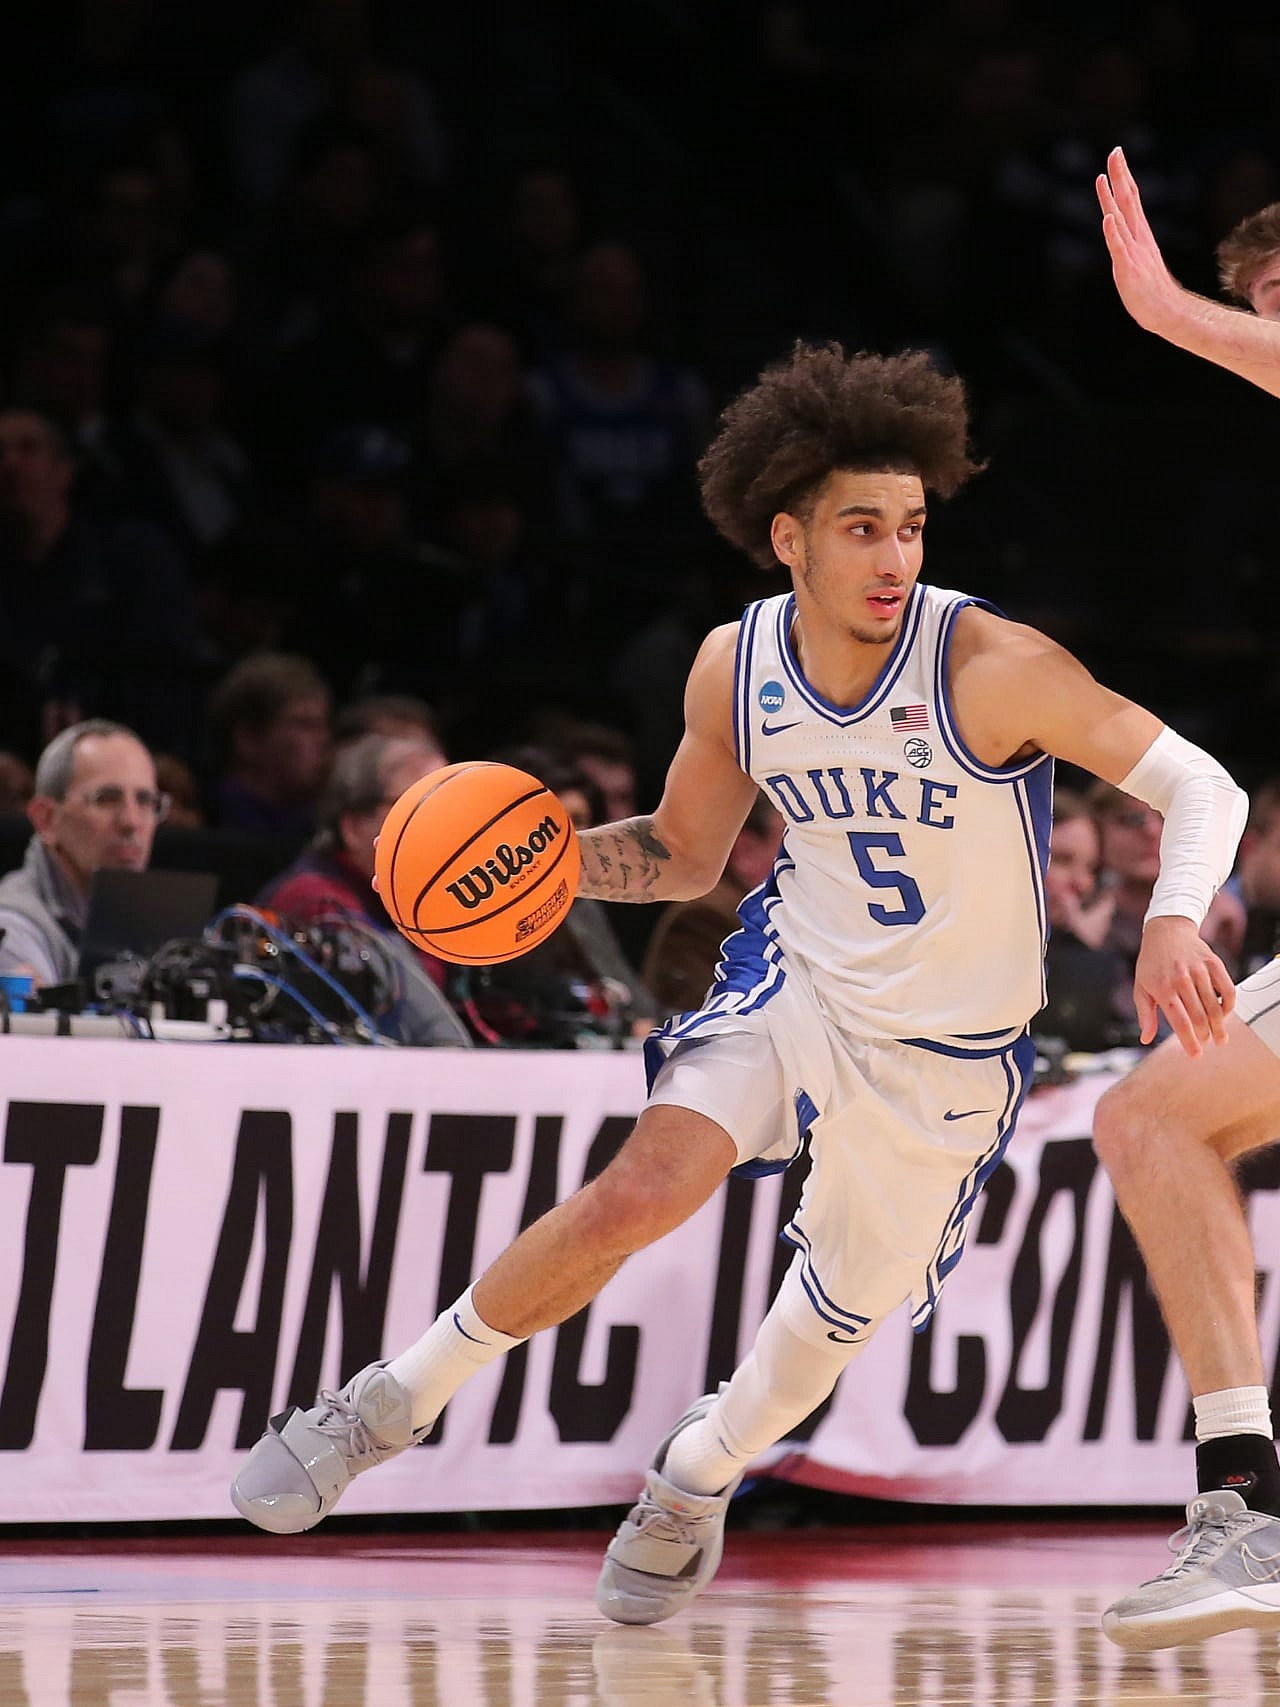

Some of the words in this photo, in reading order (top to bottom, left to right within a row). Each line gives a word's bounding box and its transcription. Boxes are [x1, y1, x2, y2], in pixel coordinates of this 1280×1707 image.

[766, 767, 958, 829] DUKE
[445, 815, 561, 909] Wilson
[510, 874, 526, 889] EVO
[846, 831, 926, 926] 5
